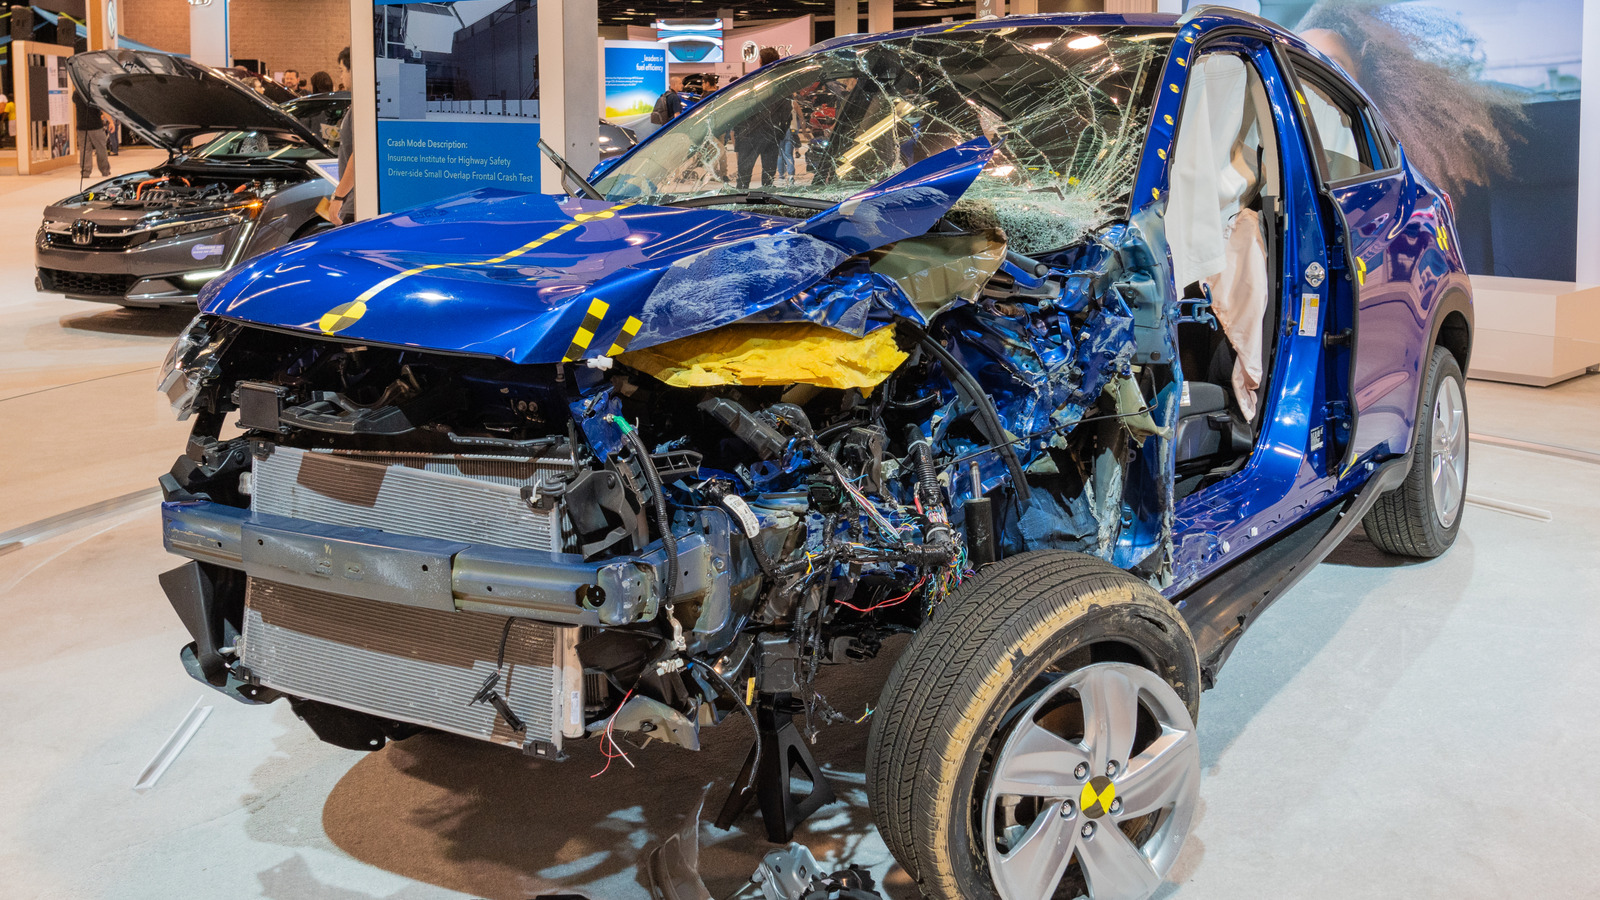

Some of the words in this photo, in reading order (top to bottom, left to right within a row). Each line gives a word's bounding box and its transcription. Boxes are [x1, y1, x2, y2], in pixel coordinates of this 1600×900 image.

[387, 138, 405, 147] Crash
[406, 139, 426, 148] Mode
[427, 139, 468, 151] Description:
[387, 153, 418, 162] Insurance
[419, 154, 446, 163] Institute
[447, 155, 457, 164] for
[458, 156, 488, 167] Highway
[489, 156, 511, 168] Safety
[387, 167, 423, 178] Driver-side
[424, 169, 442, 179] Small
[443, 170, 471, 181] Overlap
[472, 171, 496, 181] Frontal
[497, 172, 517, 182] Crash
[518, 173, 533, 183] Test
